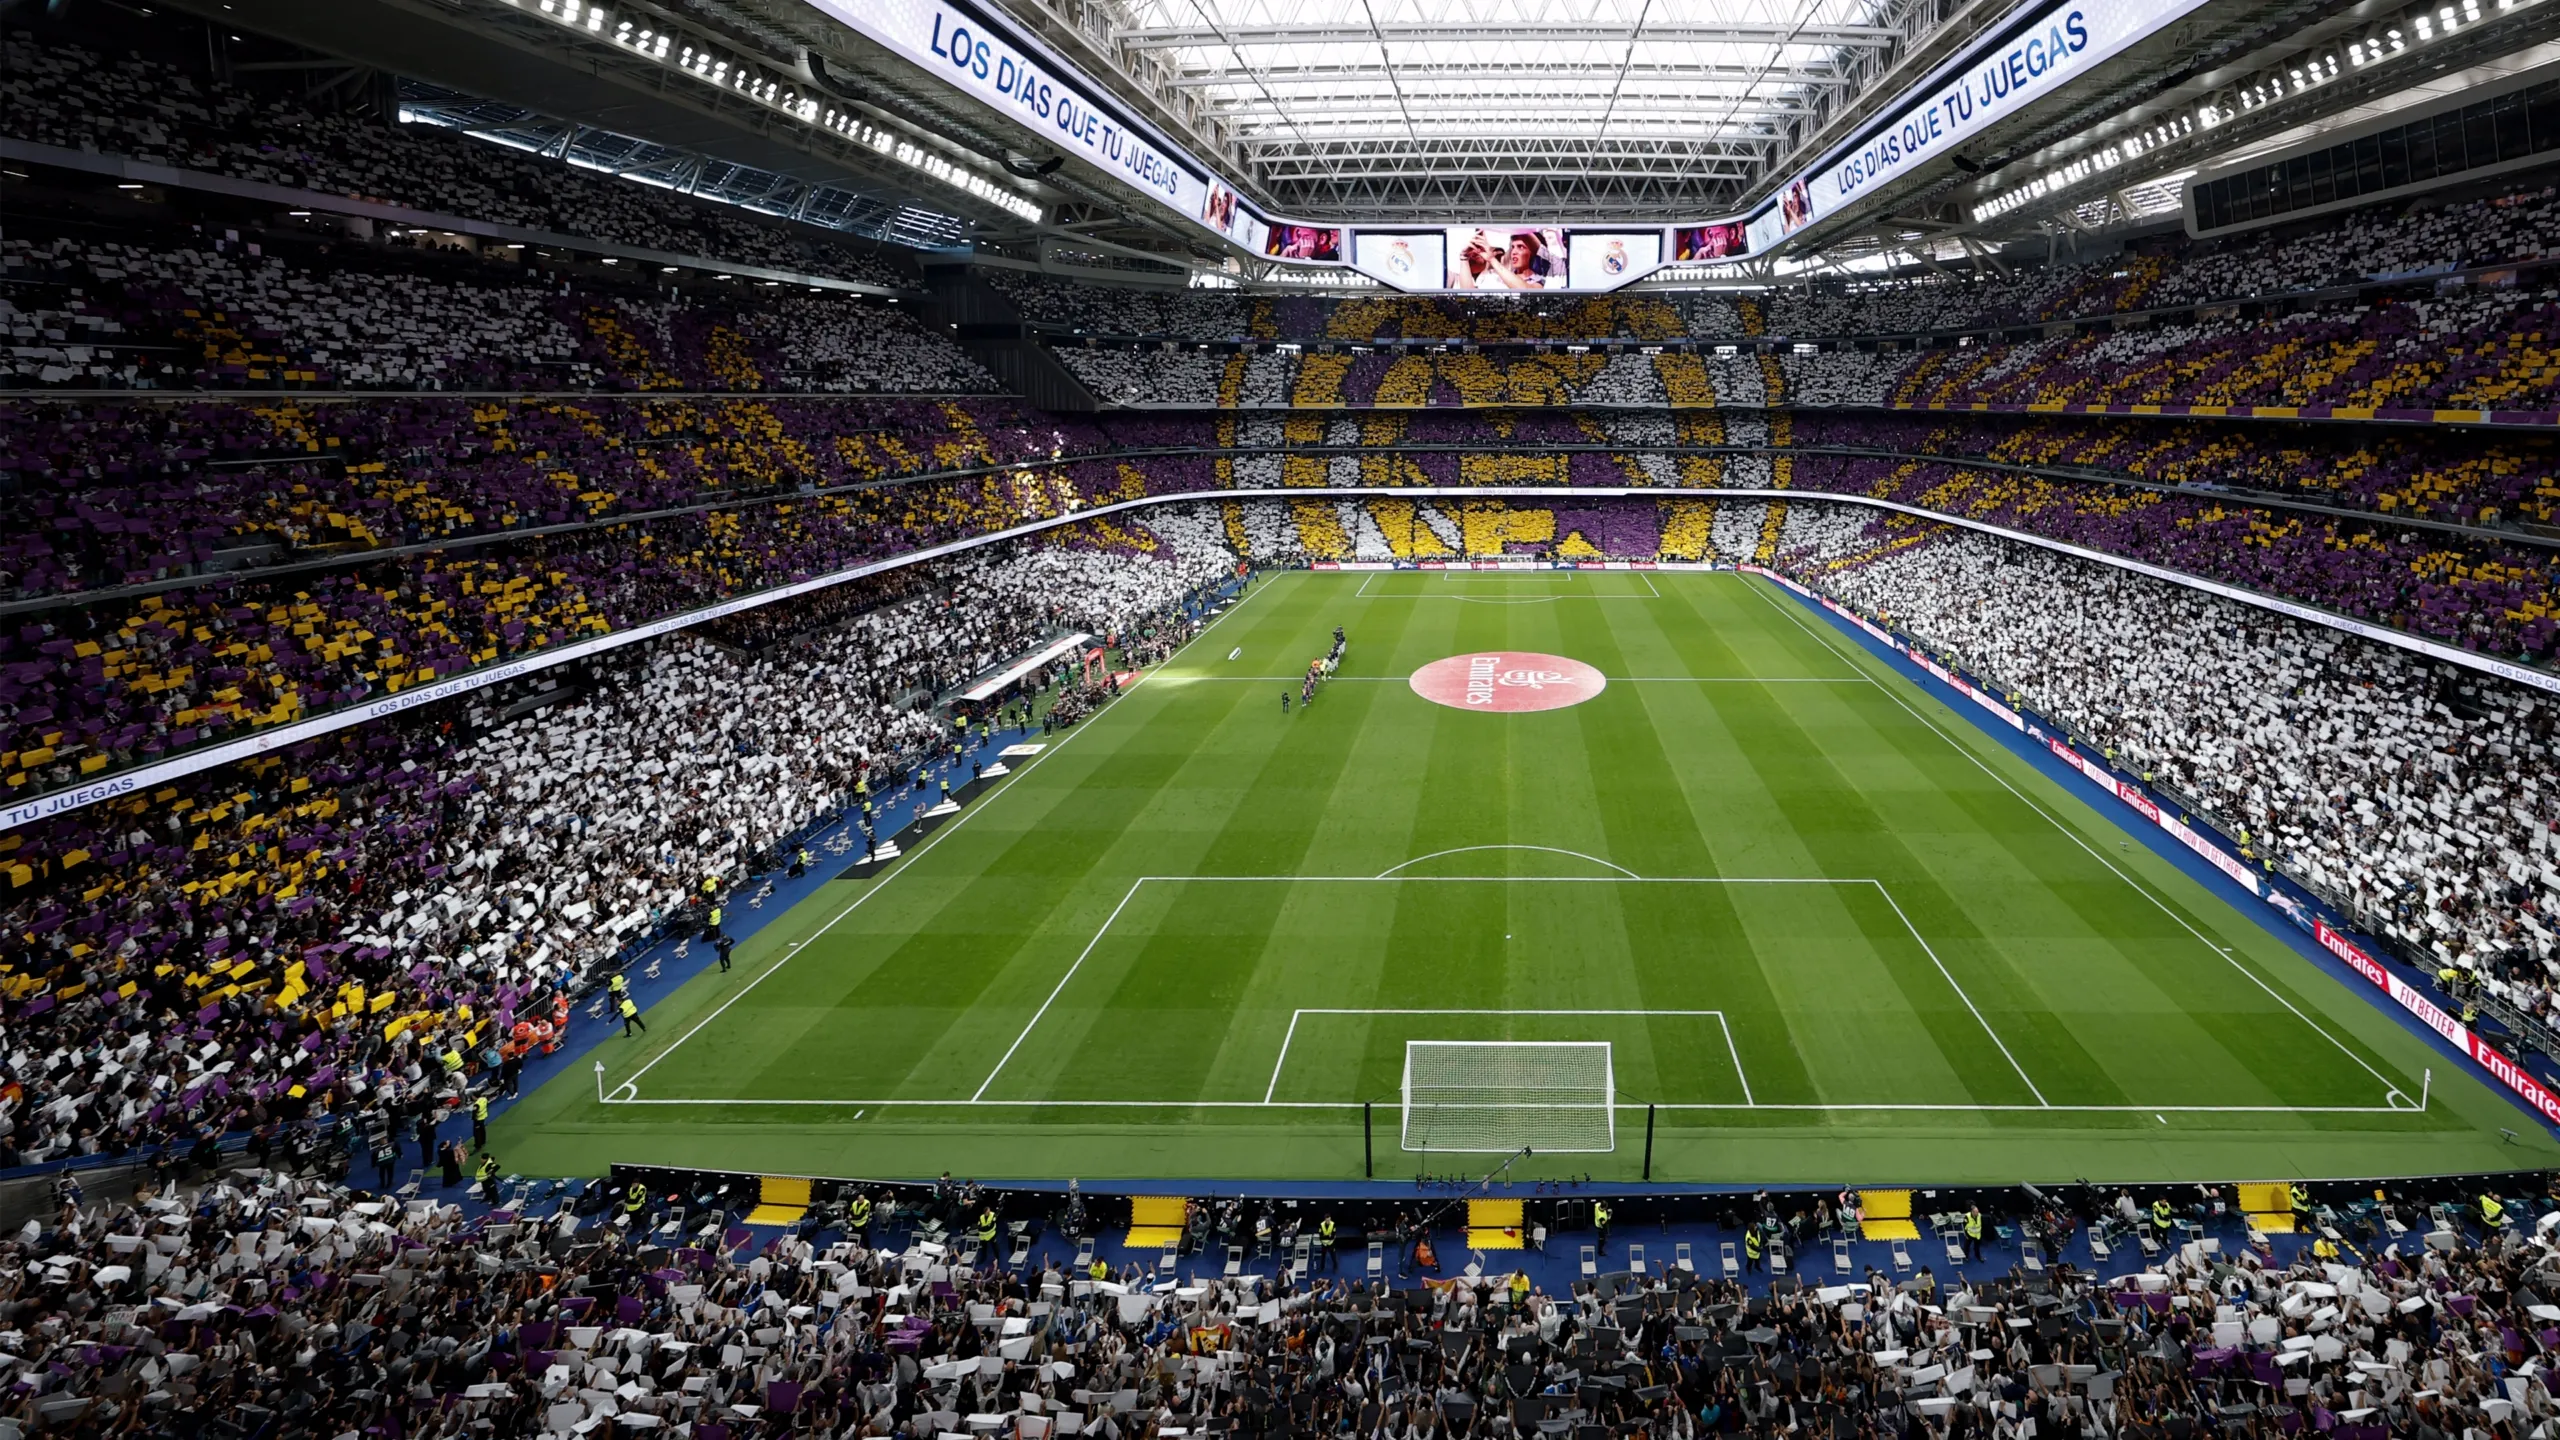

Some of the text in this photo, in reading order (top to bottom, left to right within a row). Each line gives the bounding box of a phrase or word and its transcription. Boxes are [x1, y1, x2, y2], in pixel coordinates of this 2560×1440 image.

[931, 12, 1178, 195] LOS DÍAS QUE TÚ JUEGAS
[1837, 10, 2088, 195] LOS DÍAS QUE TÚ JUEGAS
[2270, 602, 2285, 610] LOS
[2303, 610, 2320, 620] QUE
[2333, 619, 2364, 633] JUEGAS
[370, 701, 398, 716] LOS
[435, 684, 461, 697] QUE
[482, 663, 526, 683] JUEGAS
[1466, 657, 1500, 705] Emirates
[2490, 663, 2512, 676] LOS
[2052, 740, 2082, 769] Emirates
[7, 778, 134, 823] TÚ JUEGAS
[2120, 785, 2157, 820] Emirates
[2171, 820, 2243, 880] IT'S HOW YOU GET THERE
[2319, 925, 2383, 986] Emirates
[2400, 986, 2456, 1040] FLY BETTER
[378, 1146, 393, 1158] 45
